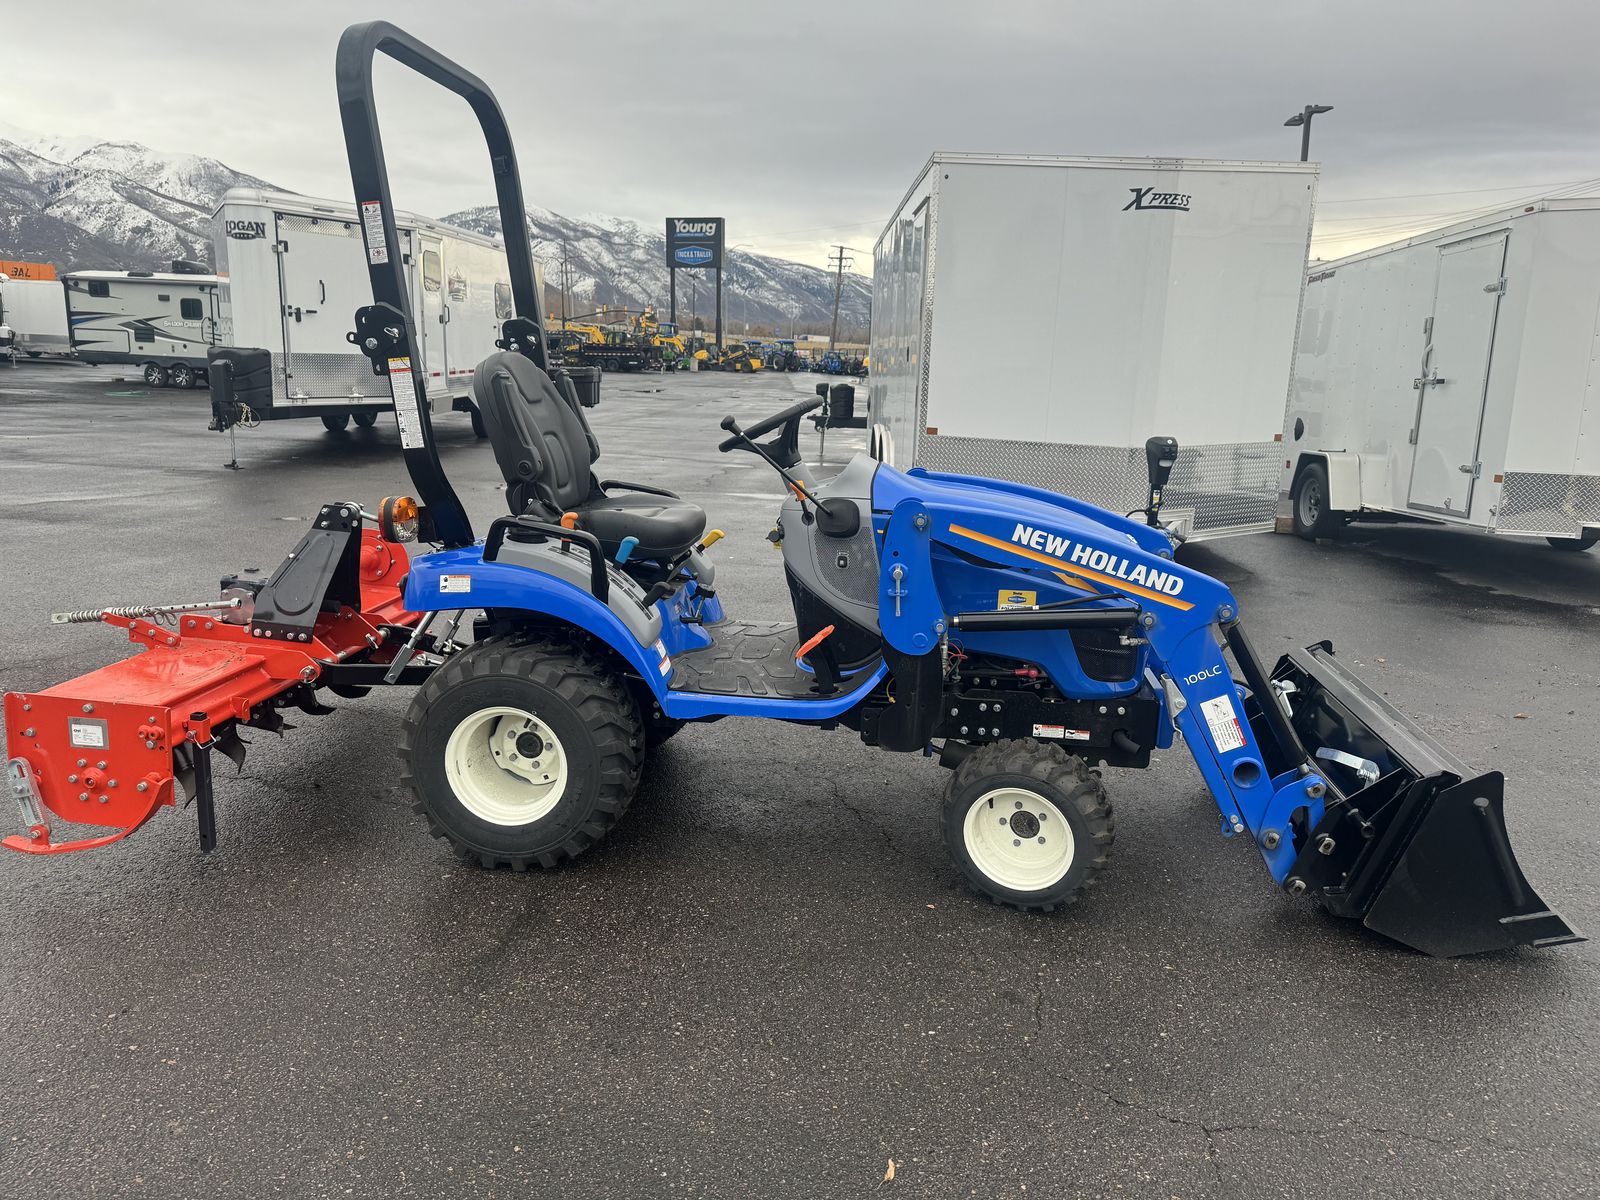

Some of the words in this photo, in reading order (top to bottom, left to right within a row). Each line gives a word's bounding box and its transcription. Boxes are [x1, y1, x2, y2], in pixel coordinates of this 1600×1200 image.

[1121, 187, 1192, 212] XPRESS
[225, 220, 267, 239] LOGAN
[673, 219, 717, 236] Young
[1011, 523, 1071, 558] NEW
[1070, 543, 1184, 596] HOLLAND
[1183, 664, 1222, 686] 100LC
